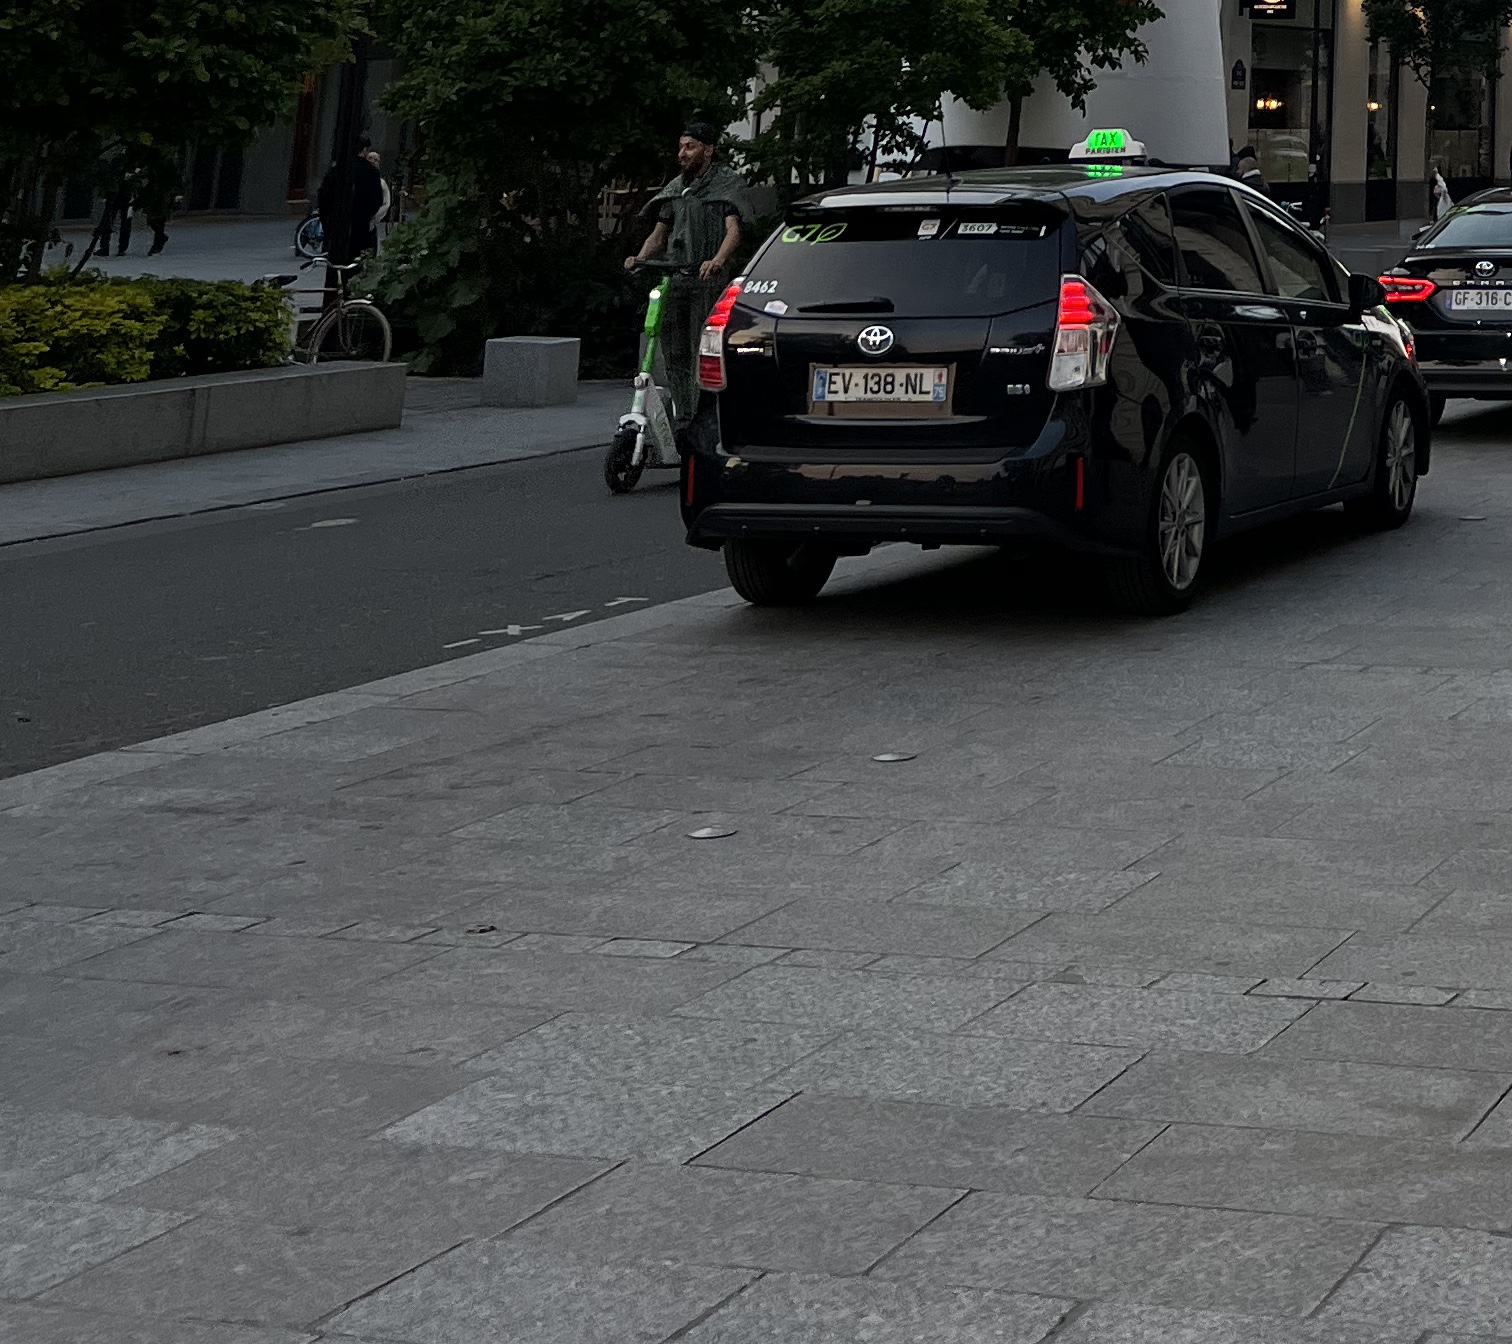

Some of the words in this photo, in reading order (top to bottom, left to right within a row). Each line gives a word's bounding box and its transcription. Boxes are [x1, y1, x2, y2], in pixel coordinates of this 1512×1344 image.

[781, 223, 823, 243] G7
[961, 223, 994, 232] 3607
[743, 280, 778, 294] 8462
[827, 372, 931, 395] EV-138-NL
